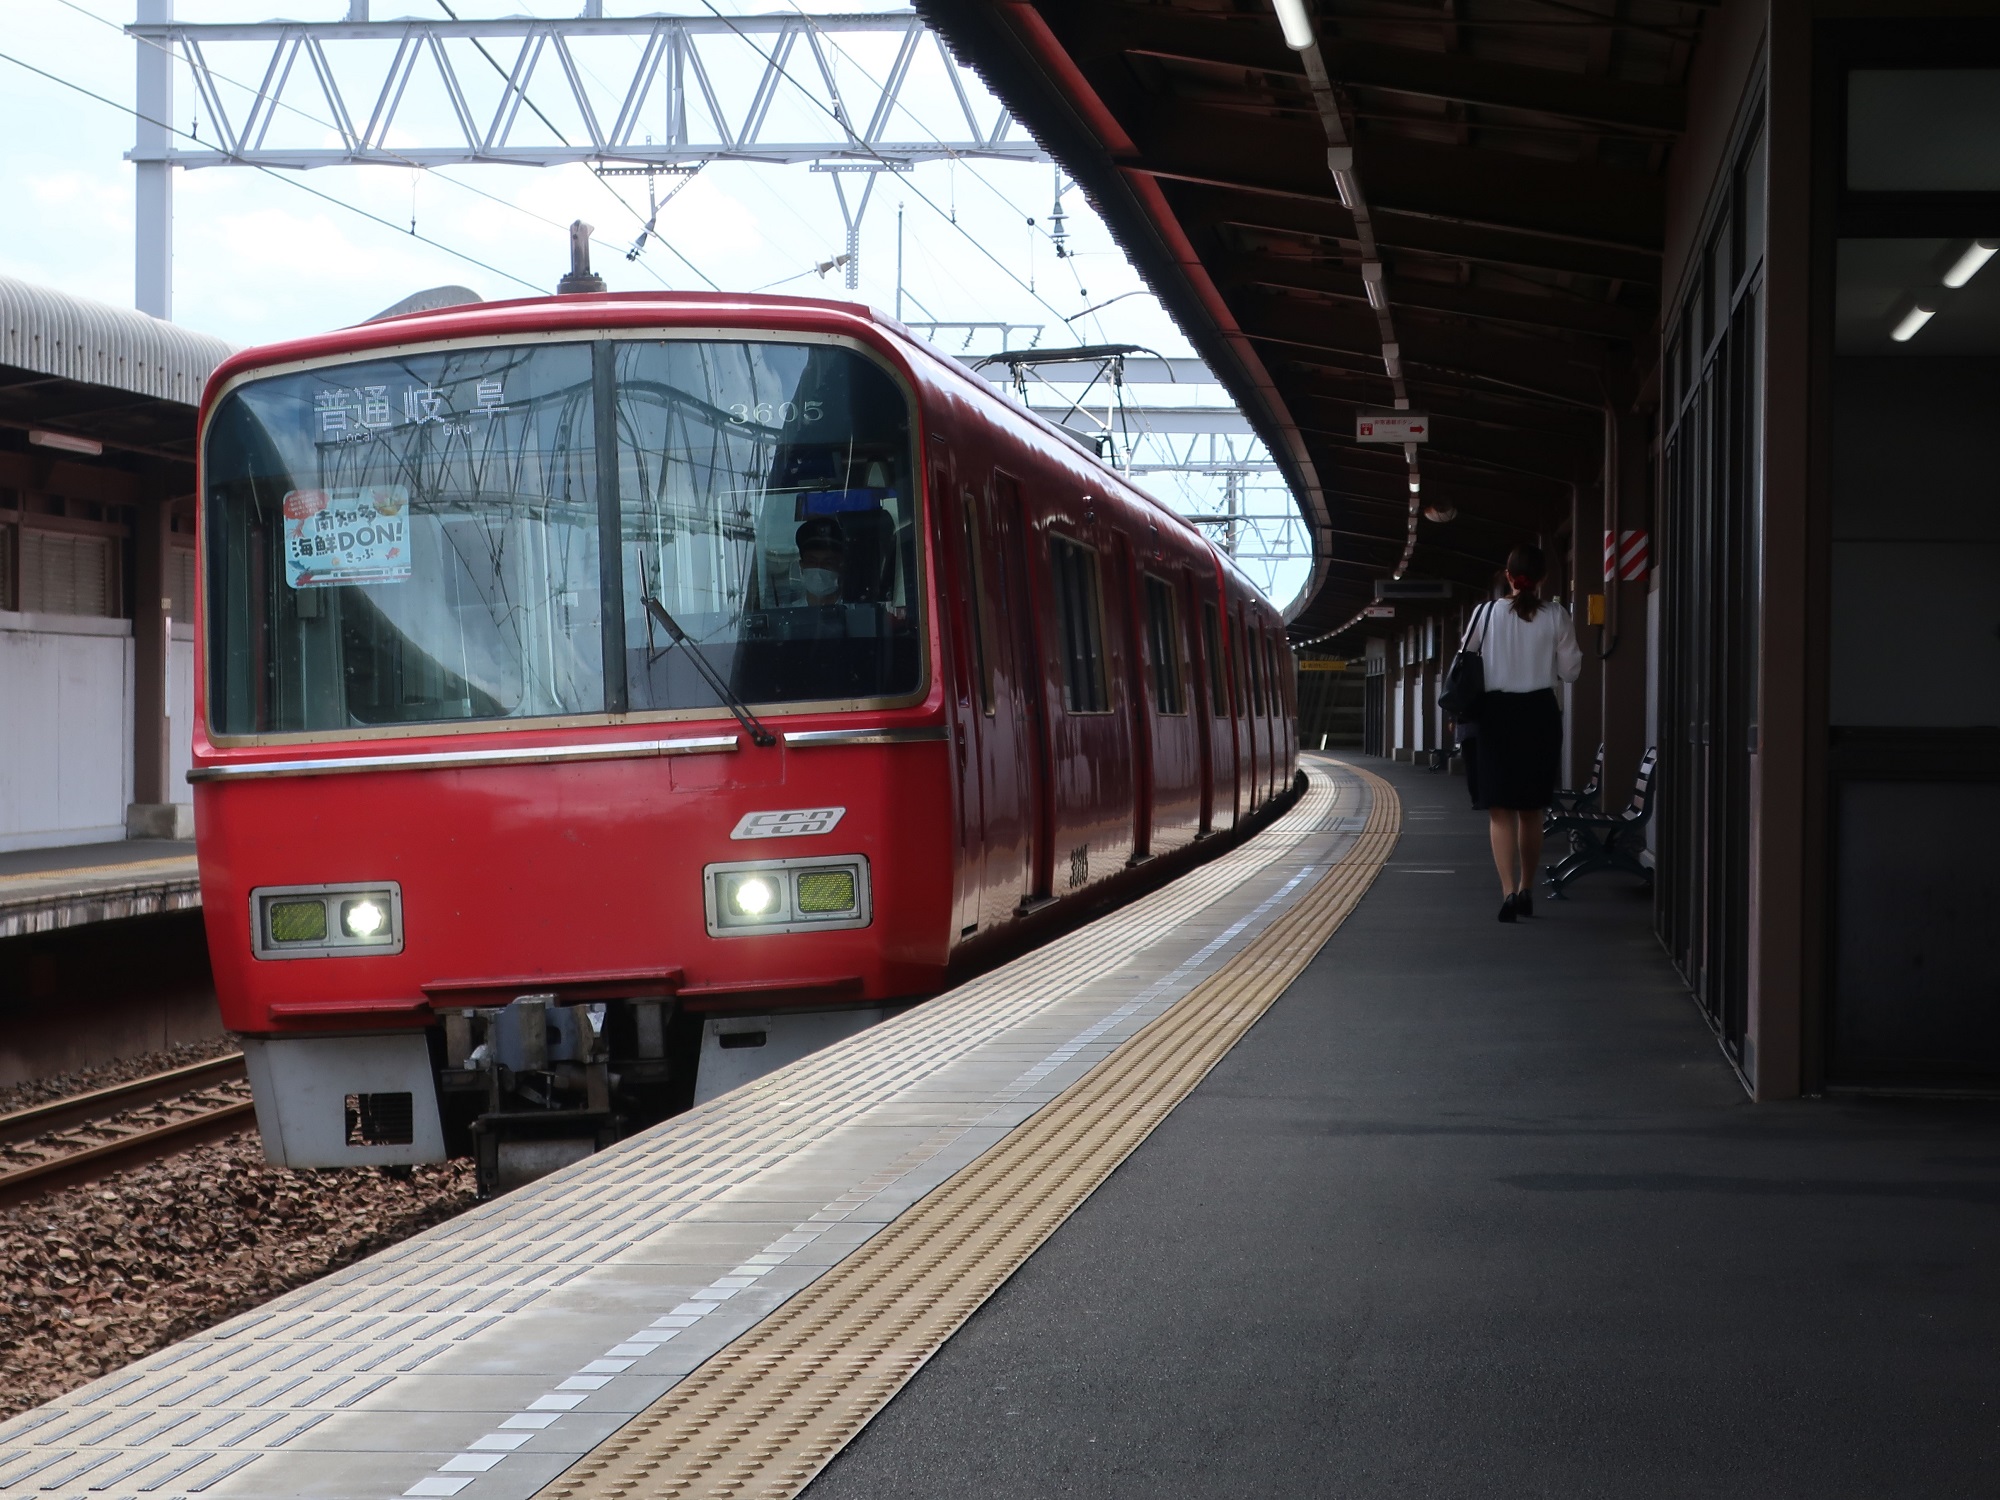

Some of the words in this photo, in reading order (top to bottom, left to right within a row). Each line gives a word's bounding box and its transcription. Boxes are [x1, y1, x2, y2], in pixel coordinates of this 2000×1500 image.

[313, 385, 392, 431] 普通
[403, 378, 510, 424] 岐阜
[729, 401, 824, 425] 3605
[335, 428, 375, 444] Local
[442, 422, 473, 436] Gifu
[315, 503, 377, 532] 南知多
[291, 522, 403, 558] 海鮮DON!
[345, 548, 374, 564] きっぷ
